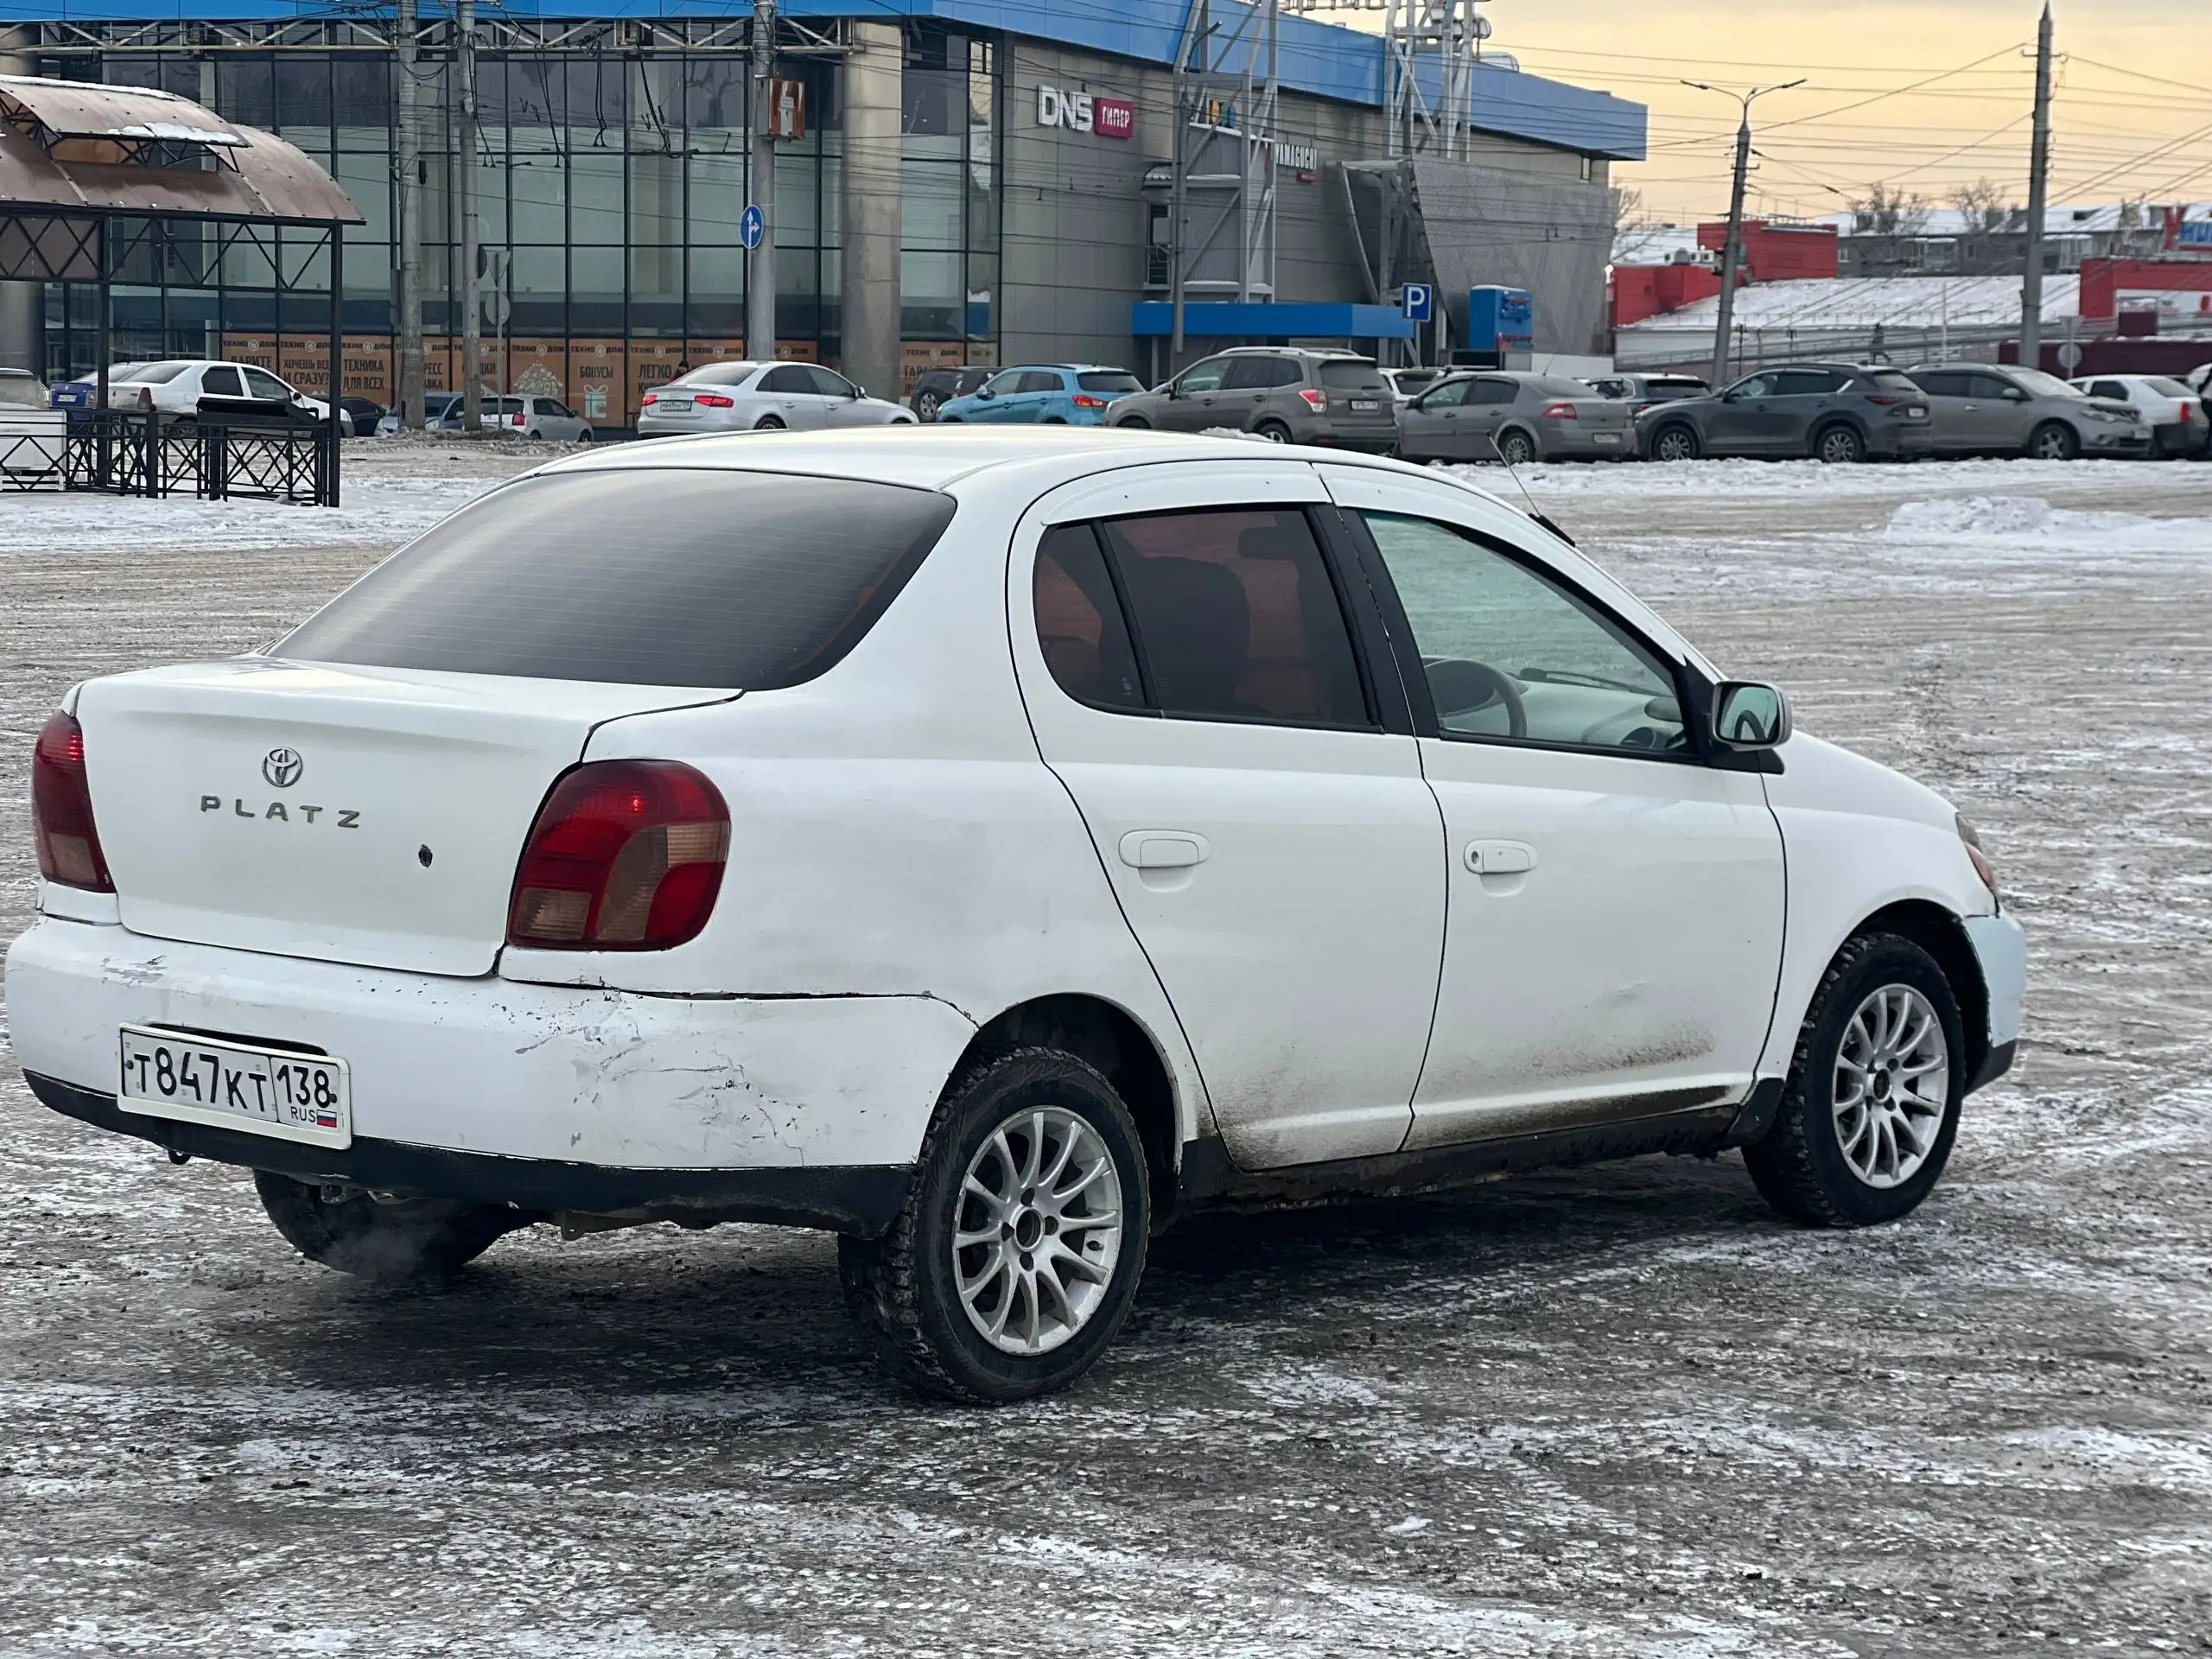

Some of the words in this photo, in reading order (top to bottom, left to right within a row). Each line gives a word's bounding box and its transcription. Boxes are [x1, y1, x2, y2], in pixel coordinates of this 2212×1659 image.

[1038, 83, 1093, 131] DNS
[1102, 105, 1130, 129] ГИПЕР
[1274, 143, 1317, 170] YAMAGUCHI
[1407, 286, 1425, 318] P
[283, 359, 315, 369] ХОЧЕШЬ
[343, 359, 384, 372] ТЕХНИКА
[580, 365, 613, 378] БОНУСЫ
[638, 364, 672, 378] ЛЕГКО
[343, 377, 361, 391] ДЛЯ
[364, 377, 385, 390] ВСЕХ
[200, 795, 359, 829] PLATZ
[276, 1065, 332, 1109] 138
[291, 1106, 316, 1123] RUS
